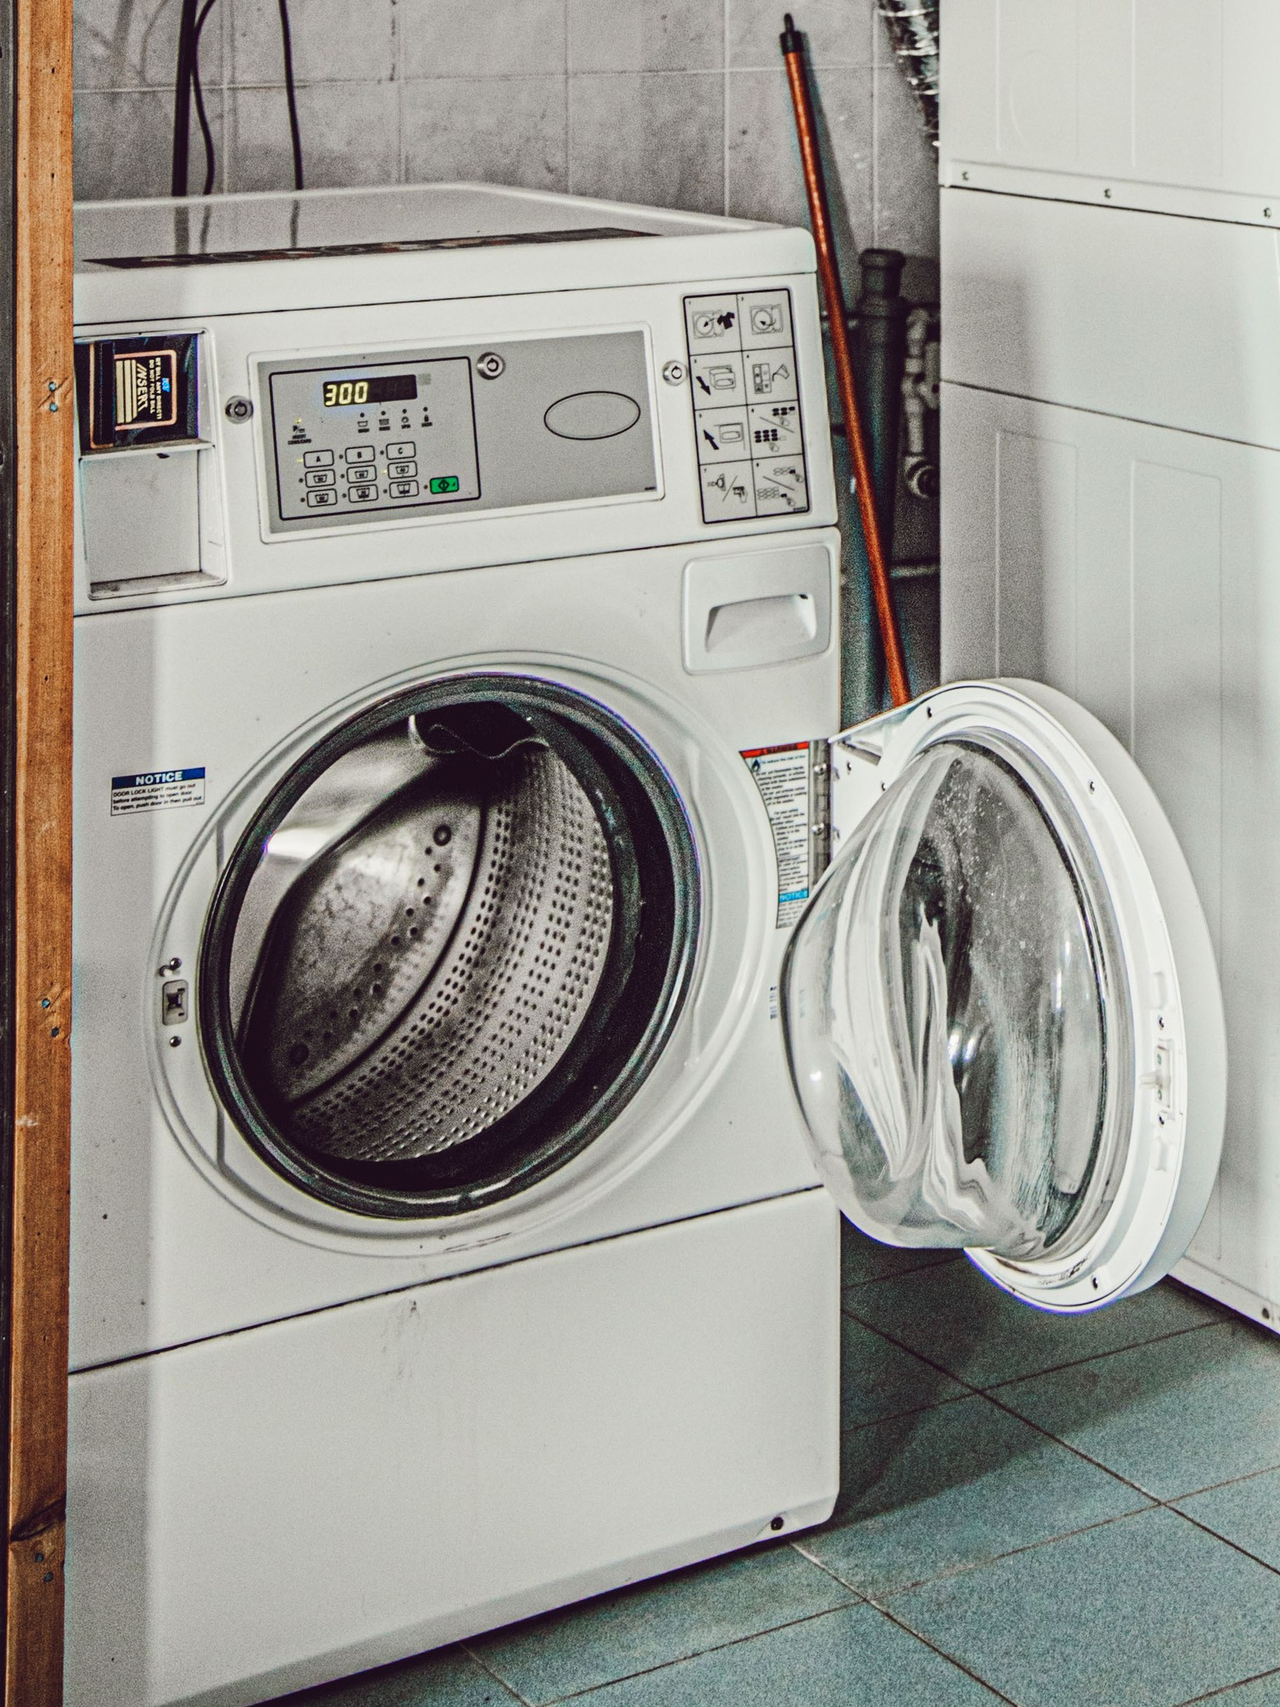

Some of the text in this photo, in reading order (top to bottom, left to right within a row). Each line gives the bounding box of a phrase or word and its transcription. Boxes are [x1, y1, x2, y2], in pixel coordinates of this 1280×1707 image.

[149, 359, 155, 368] DO
[136, 363, 149, 412] INSERT
[325, 381, 369, 406] 300
[356, 451, 363, 459] B
[397, 447, 404, 455] C
[315, 455, 321, 463] A
[135, 771, 183, 786] NOTICE
[113, 790, 130, 798] DOOR
[113, 797, 130, 805] before
[130, 794, 159, 803] attempting
